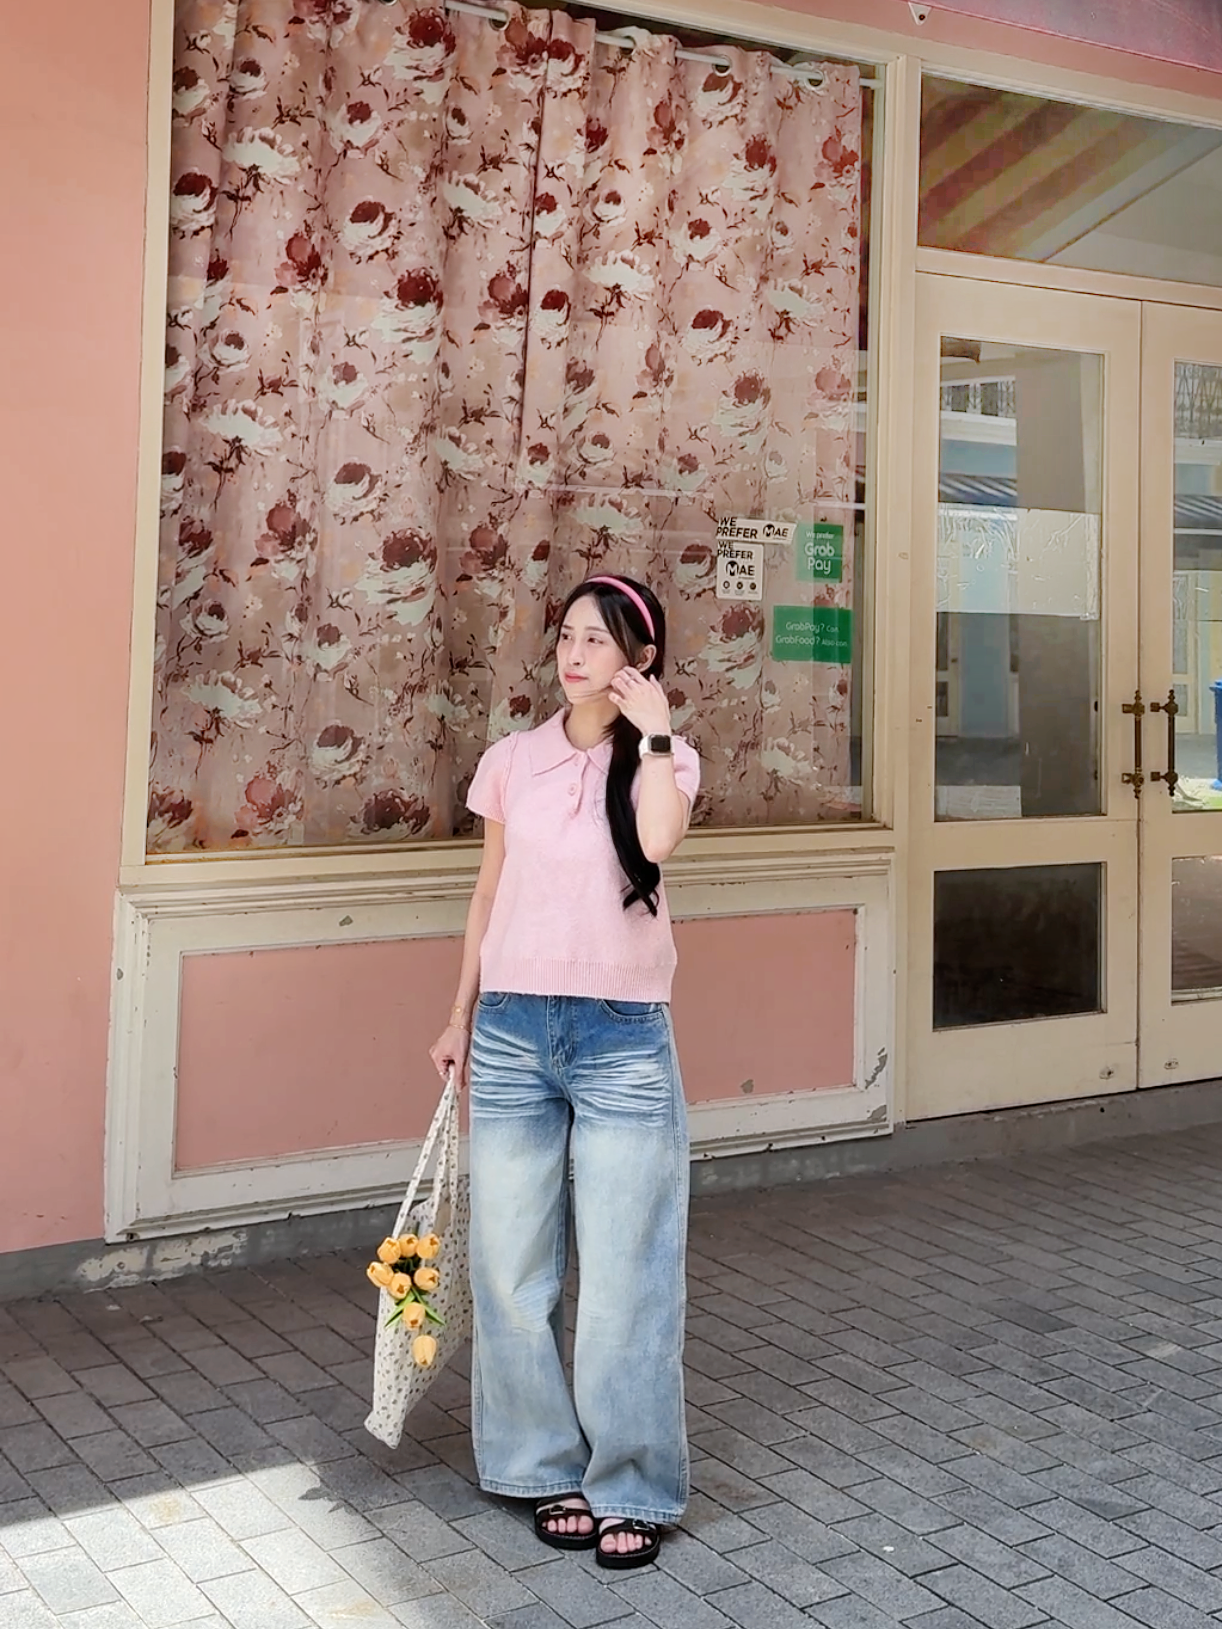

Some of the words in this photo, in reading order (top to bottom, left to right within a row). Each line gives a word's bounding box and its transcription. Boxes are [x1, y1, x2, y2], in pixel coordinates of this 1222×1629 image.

[719, 517, 737, 526] WE
[716, 527, 757, 538] PREFER
[717, 549, 753, 559] PREFER
[805, 542, 835, 557] Grab
[807, 558, 831, 574] Pay
[786, 622, 825, 633] GrabPay?
[776, 635, 820, 645] GrabFood?
